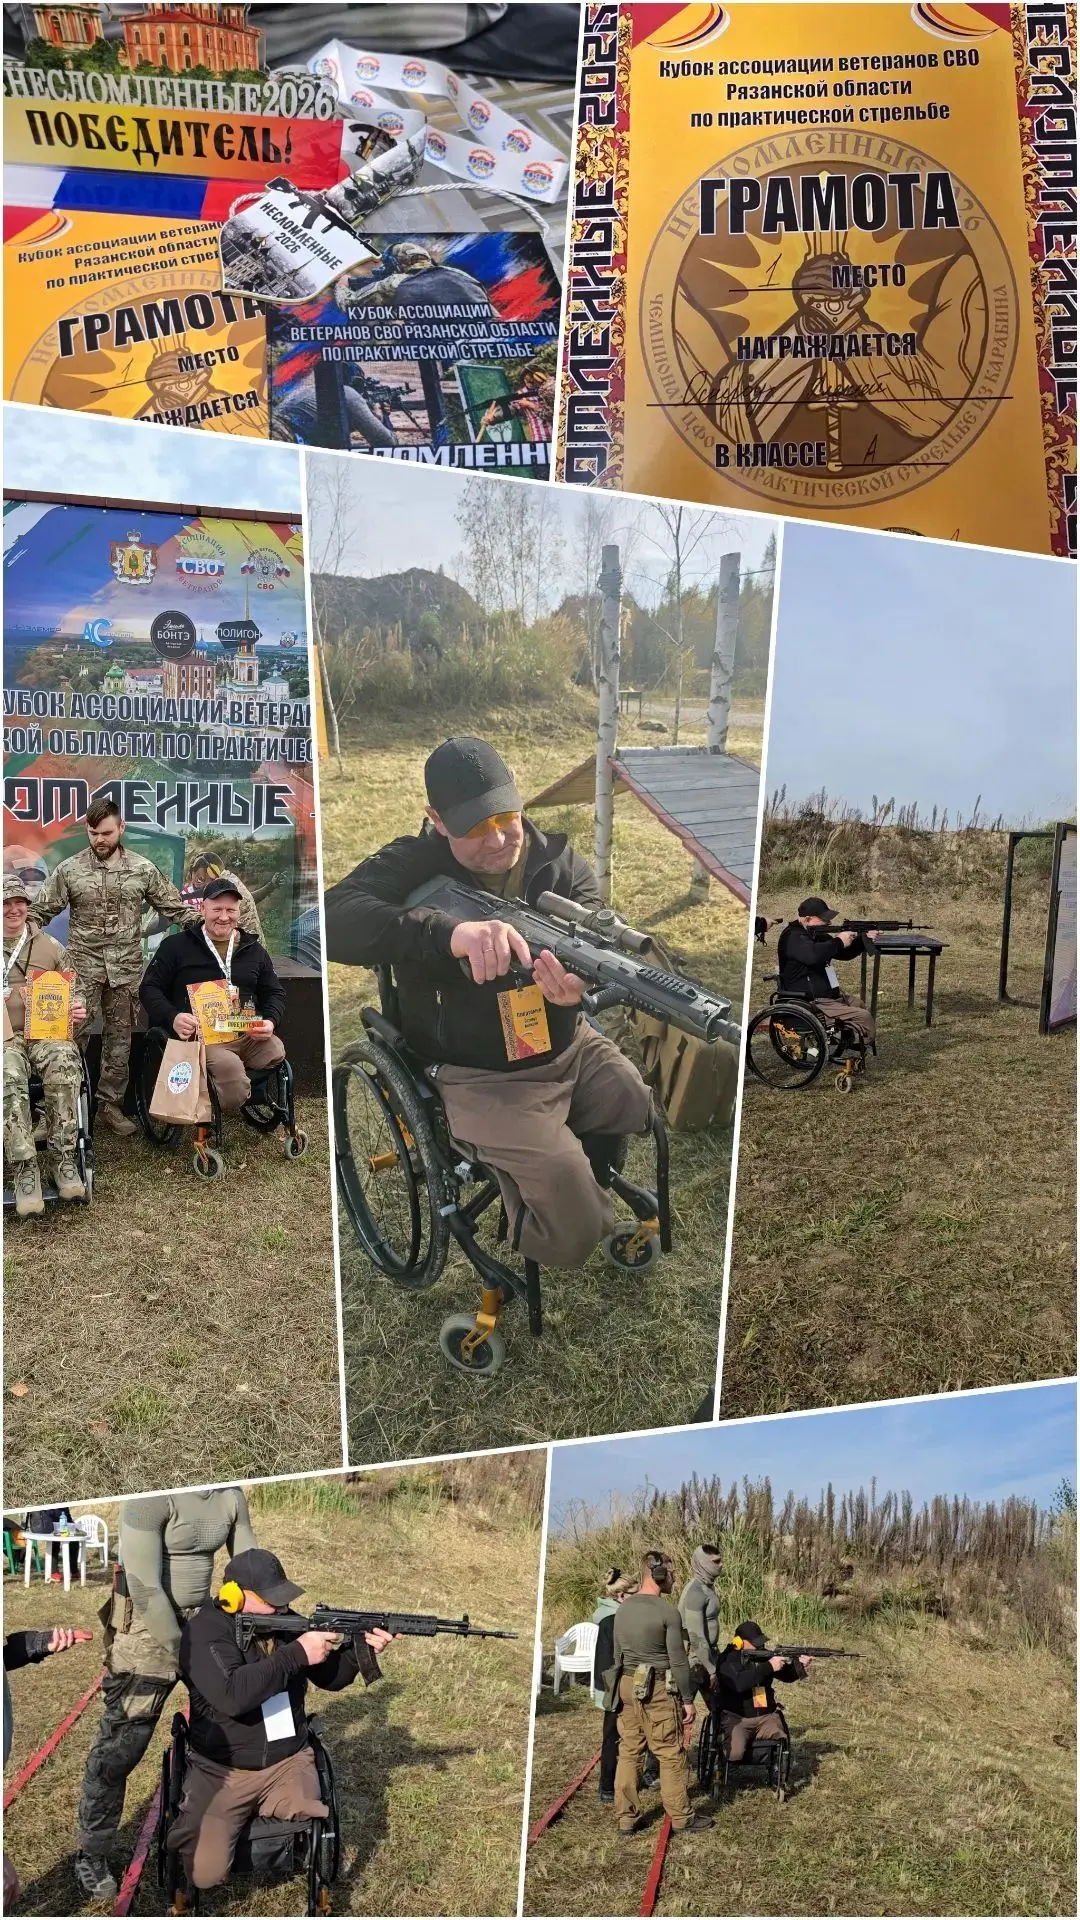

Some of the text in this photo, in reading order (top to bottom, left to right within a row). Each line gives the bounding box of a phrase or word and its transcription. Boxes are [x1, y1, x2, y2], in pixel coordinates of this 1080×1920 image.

[659, 49, 980, 79] Кубок ассоциации ветеранов СВО
[726, 78, 912, 101] Рязанской области
[690, 102, 950, 128] по практической стрельбе
[24, 107, 292, 167] ПОБЕДИТЕЛЬ!
[699, 172, 961, 235] ГРАМОТА
[18, 220, 225, 263] Кубок ассоциации ветерано
[259, 201, 343, 270] НЕСЛОМЛЕННЫЕ
[274, 232, 302, 254] 2026
[74, 236, 219, 269] Рязанской области
[46, 249, 220, 290] по практической стре
[758, 253, 783, 288] 1
[831, 263, 907, 288] МЕСТО
[348, 303, 493, 321] КУБОК АССОЦИАЦИИ
[290, 320, 558, 342] ВЕТЕРАНОВ СВО РЯЗАНСКОЙ ОБЛАСТИ
[736, 331, 917, 361] НАГРАЖДАЕТСЯ
[984, 283, 1009, 389] КАРАБИНА
[177, 344, 241, 374] МЕСТО
[322, 341, 536, 362] ПО ПРАКТИЧЕСКОЙ СТРЕЛЬБЕ
[649, 293, 682, 402] ЧЕМПИОНА
[121, 357, 135, 385] 1
[135, 390, 260, 427] АЖДАЕТСЯ
[974, 384, 995, 432] ИЗ
[715, 443, 730, 468] В
[736, 441, 827, 467] КЛАССЕ
[897, 409, 978, 481] СТРЕЛЬБЕ
[181, 559, 219, 576] СВО
[157, 630, 190, 641] БОНТЭ
[216, 627, 261, 640] ПОЛИГОН
[69, 692, 224, 727] АССОЦИАЦИИ
[48, 728, 156, 758] ОБЛАСТИ
[160, 732, 192, 760] ПО
